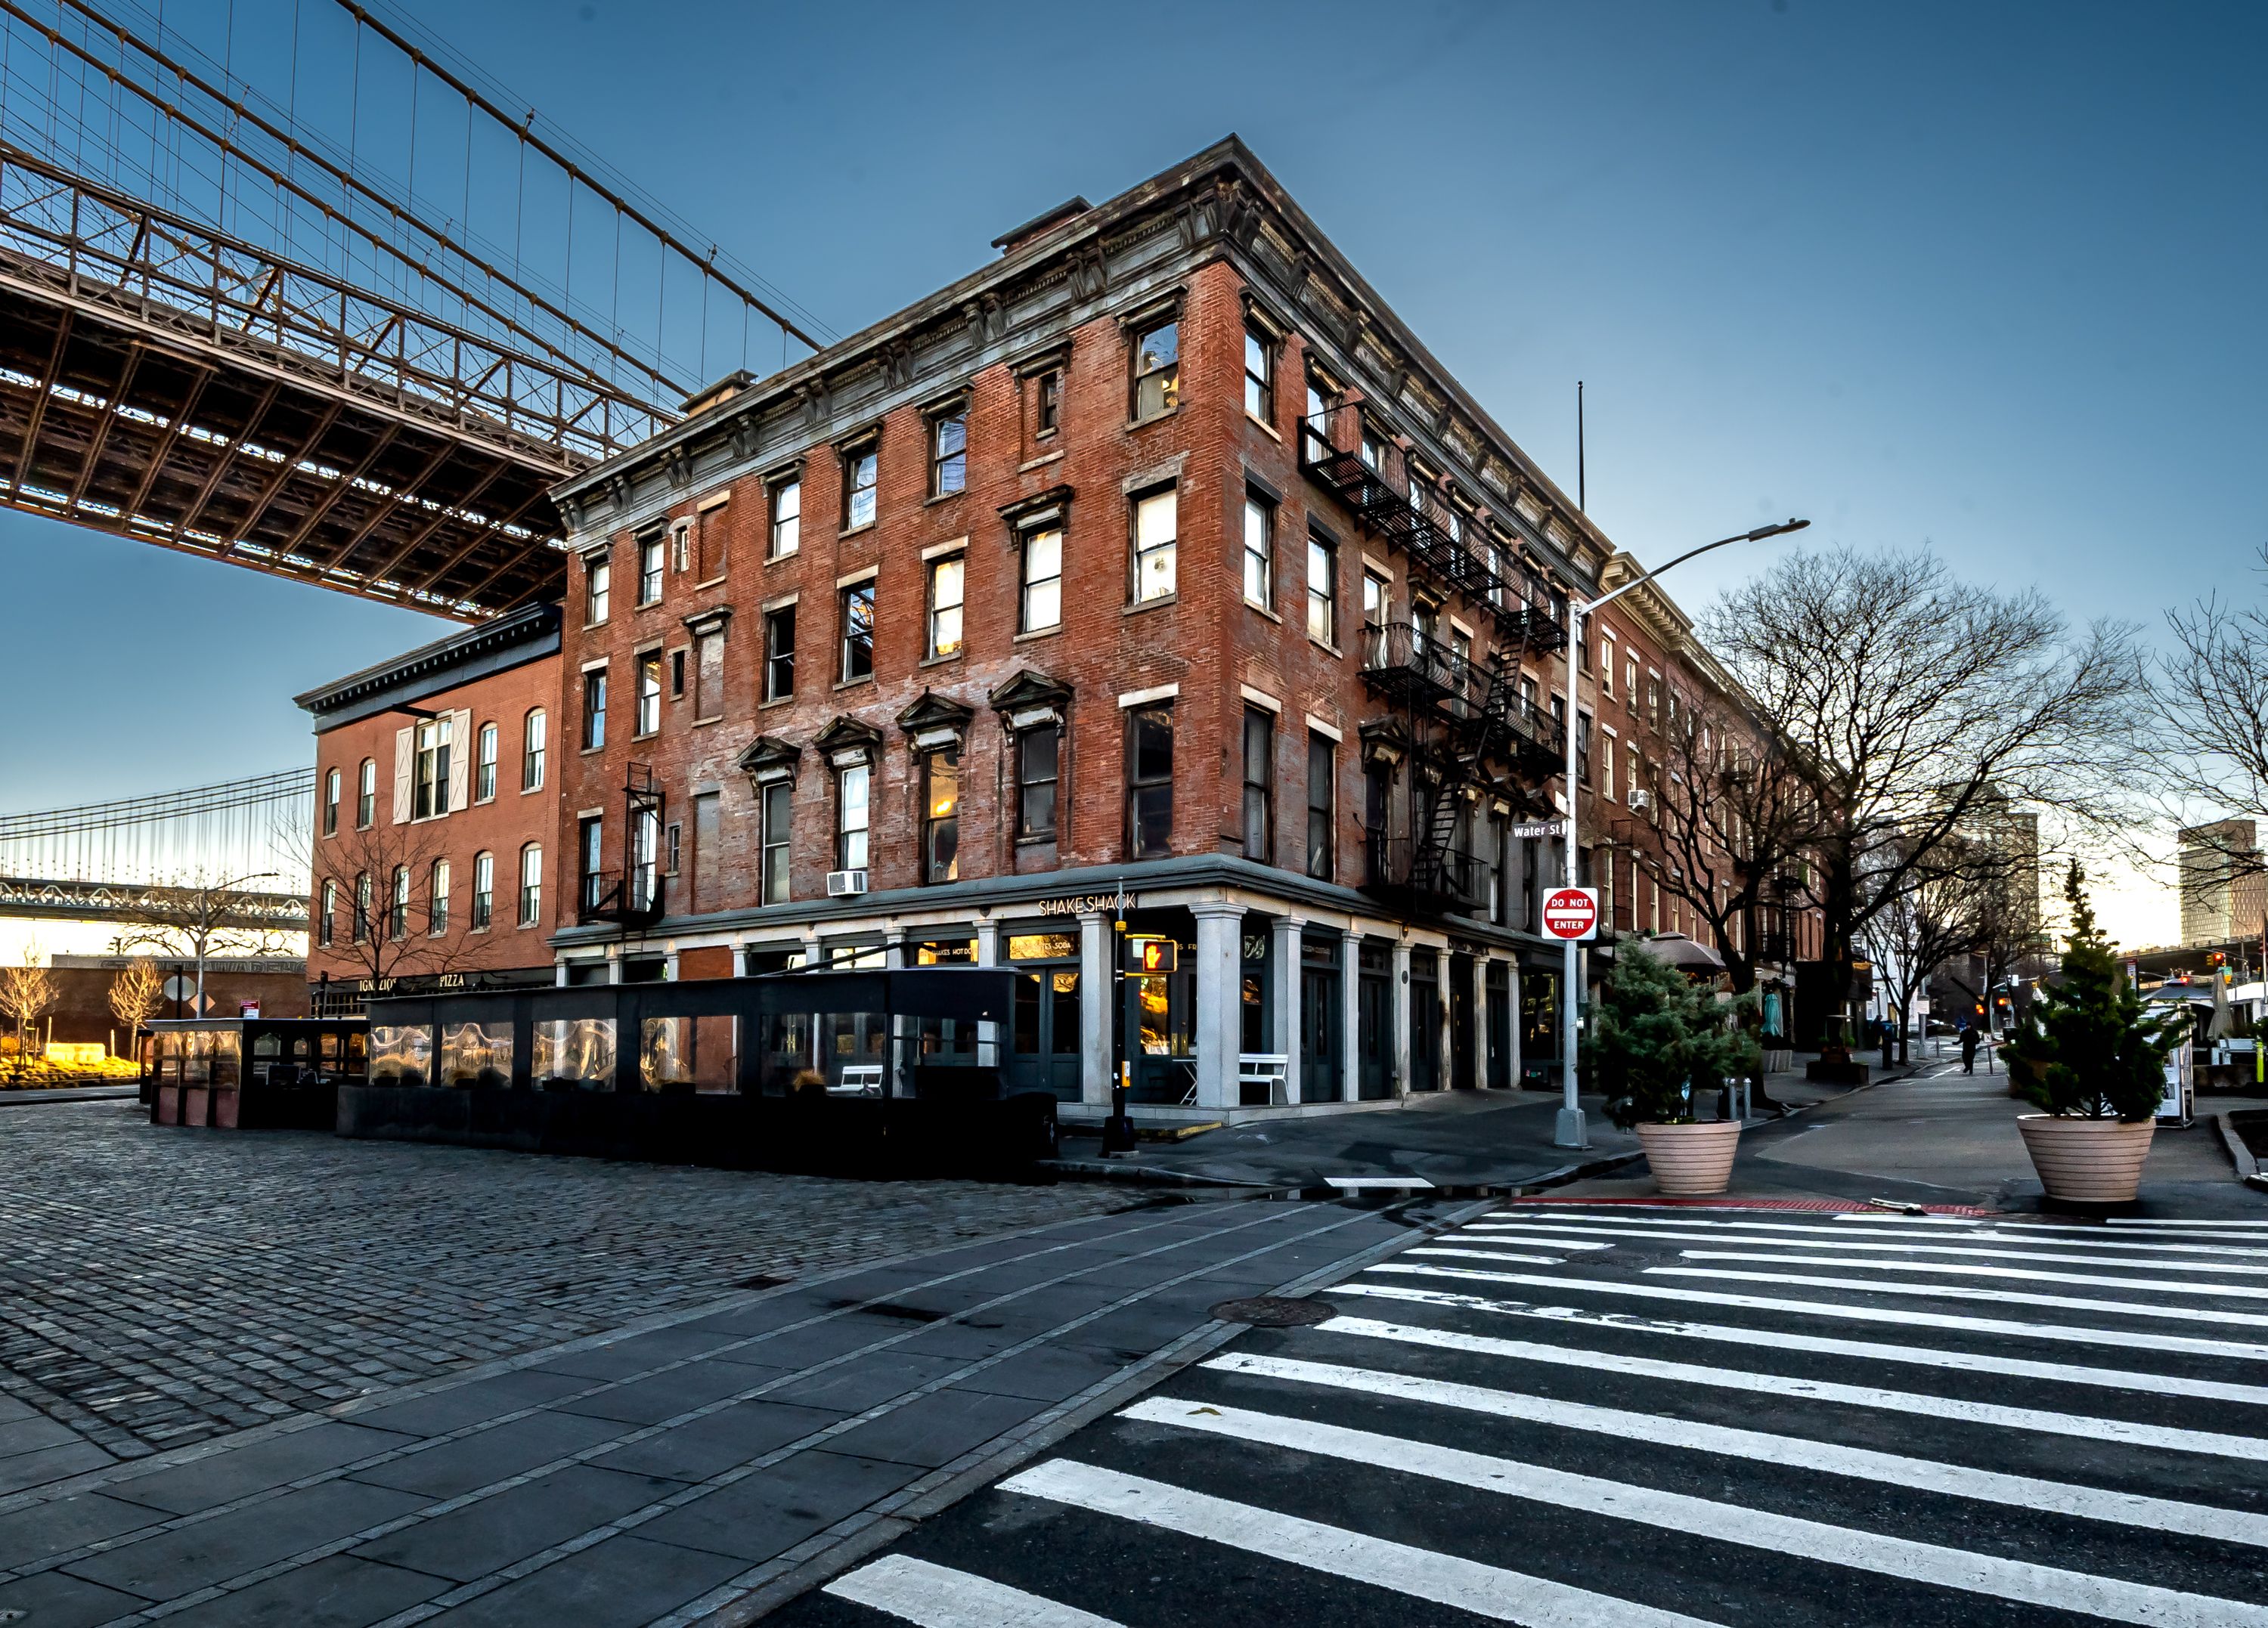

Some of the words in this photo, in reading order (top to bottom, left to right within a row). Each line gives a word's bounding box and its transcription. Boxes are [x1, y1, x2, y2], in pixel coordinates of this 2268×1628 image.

[1514, 826, 1545, 837] Water
[1548, 825, 1560, 835] St
[1039, 897, 1084, 916] SHAKE
[1086, 893, 1136, 913] SHACK
[1551, 898, 1564, 907] DO
[1569, 898, 1588, 907] NOT
[1554, 921, 1585, 930] ENTER
[439, 974, 464, 987] PIZZA
